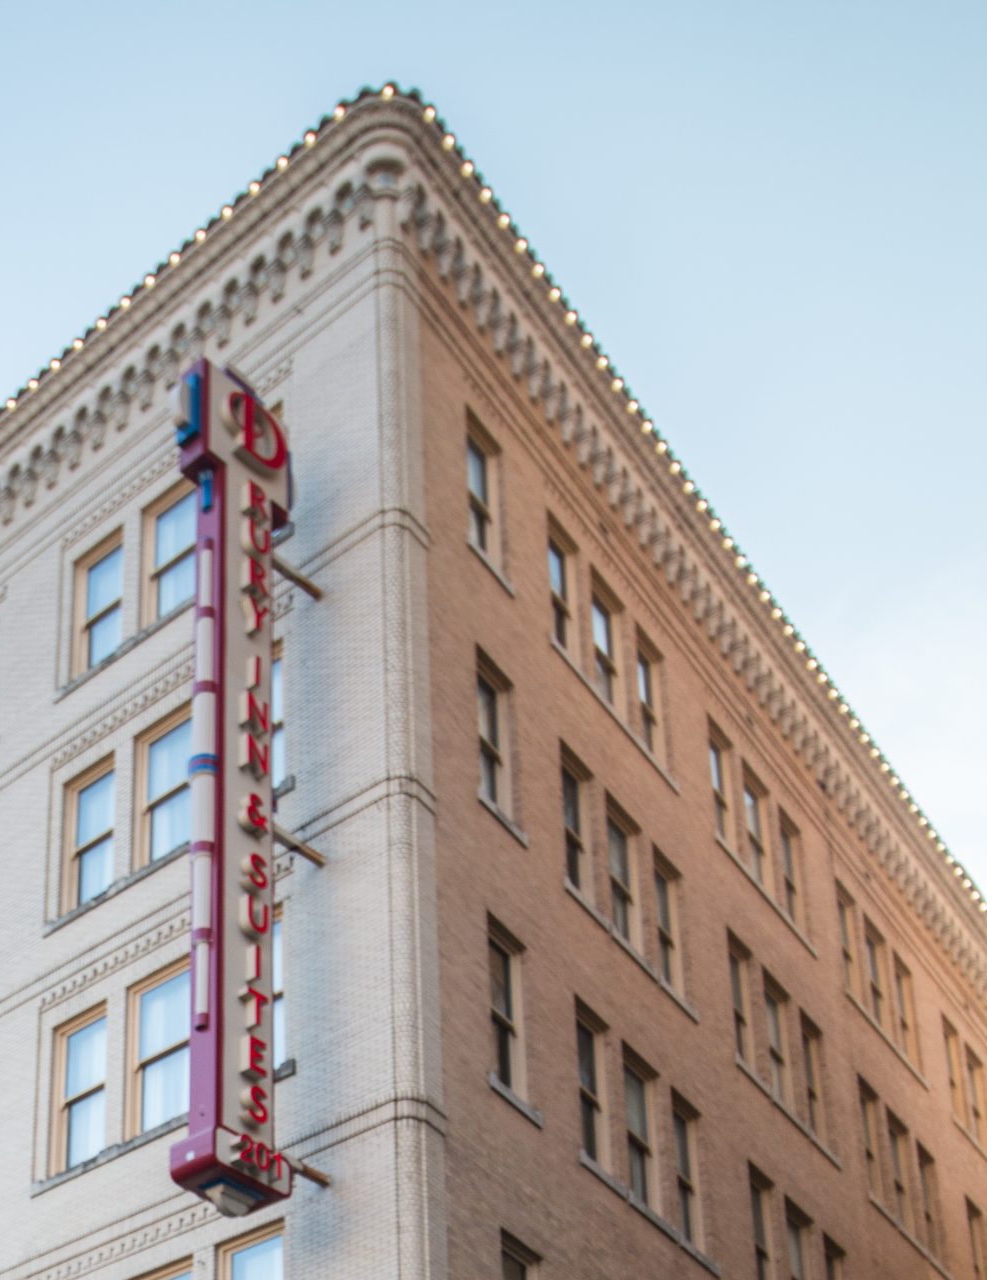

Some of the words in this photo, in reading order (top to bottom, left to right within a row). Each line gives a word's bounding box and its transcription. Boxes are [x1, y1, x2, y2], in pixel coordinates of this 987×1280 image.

[227, 391, 287, 632] DRURY
[243, 656, 269, 776] INN
[243, 793, 269, 834] &
[243, 853, 270, 1125] SUITES
[239, 1132, 283, 1181] 201
